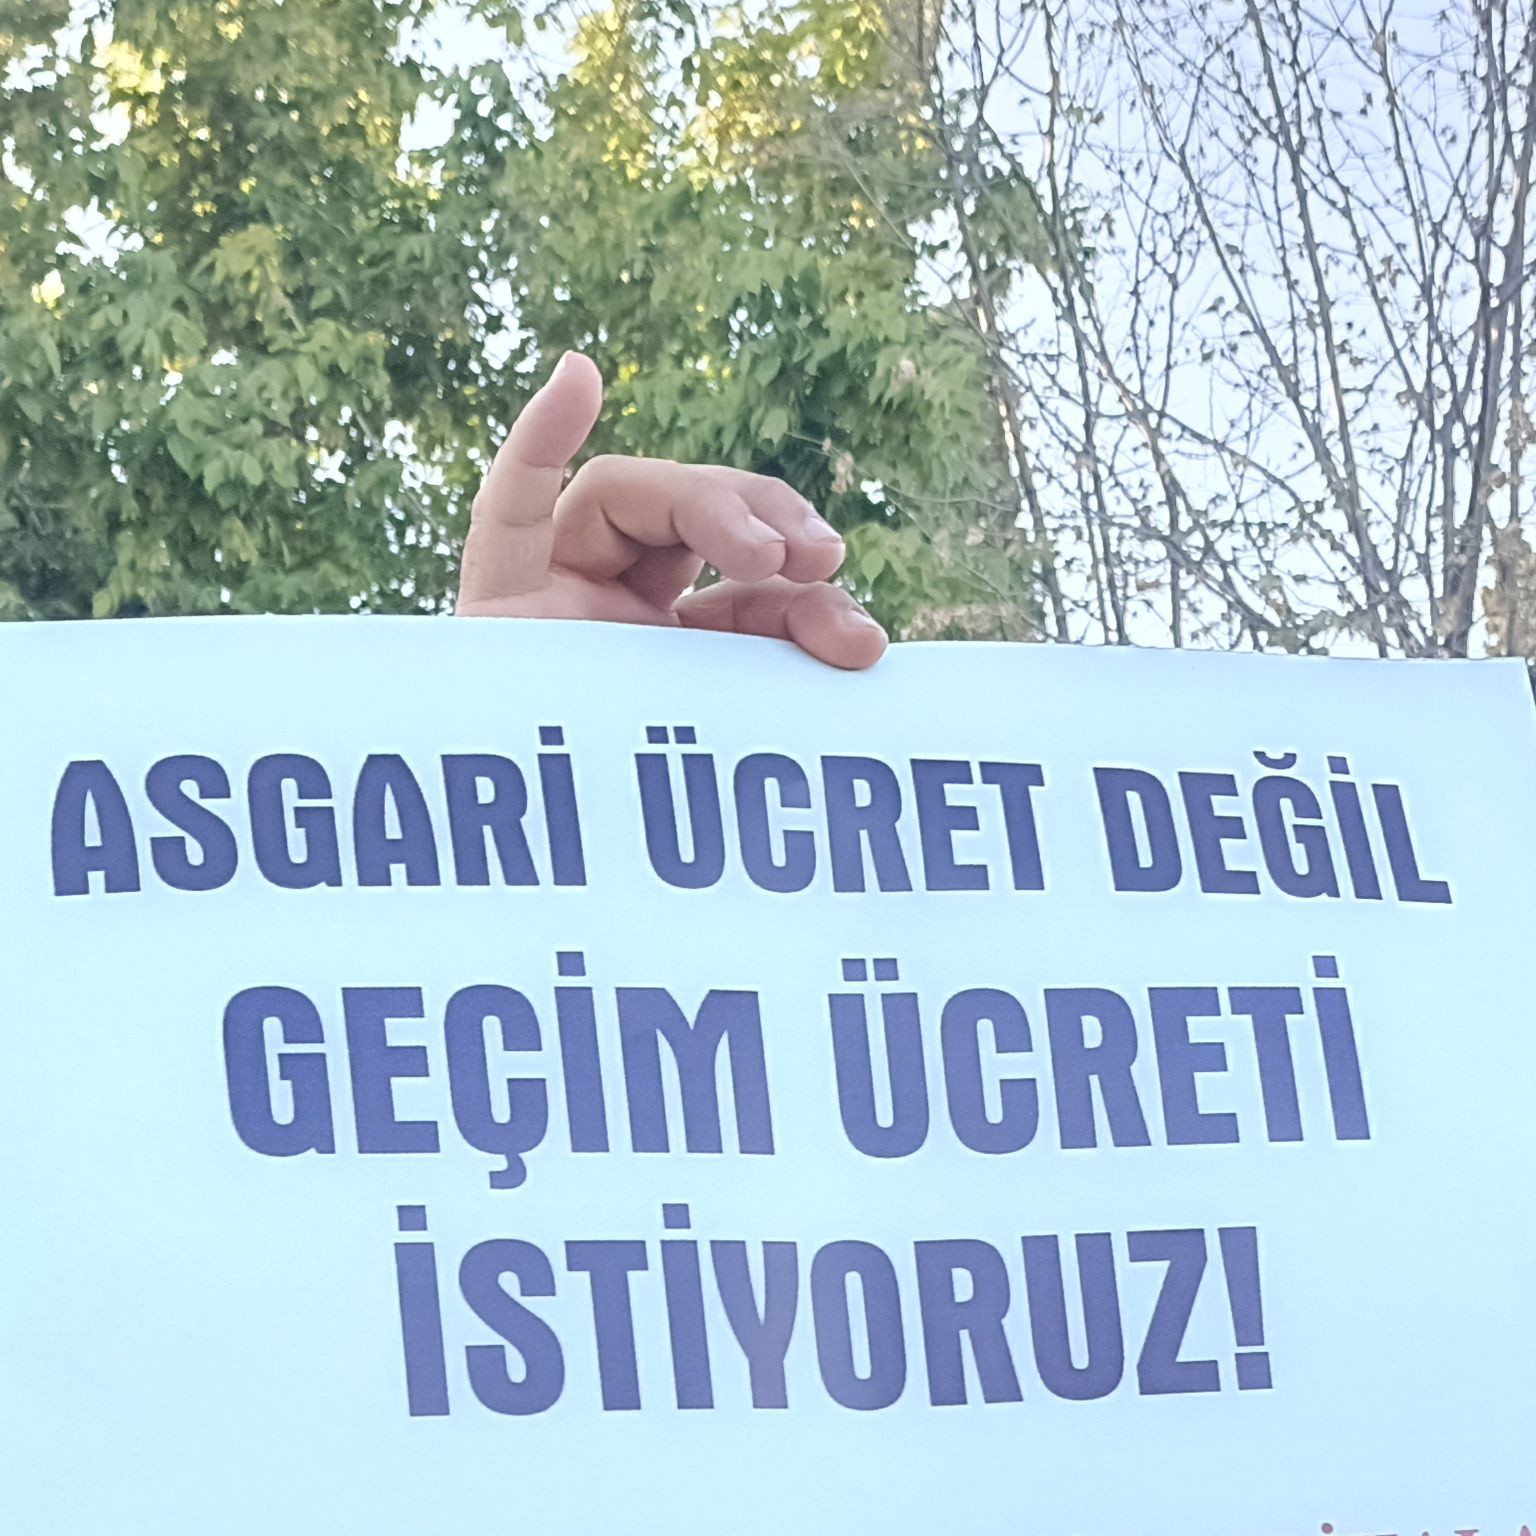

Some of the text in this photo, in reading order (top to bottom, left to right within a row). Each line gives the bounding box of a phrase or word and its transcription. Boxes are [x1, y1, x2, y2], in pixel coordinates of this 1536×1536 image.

[50, 725, 1453, 905] ASGARİ ÜCRET DEĞİL
[222, 950, 1371, 1190] GEÇİM ÜCRETİ
[393, 1202, 1273, 1418] İSTİYORUZ!
